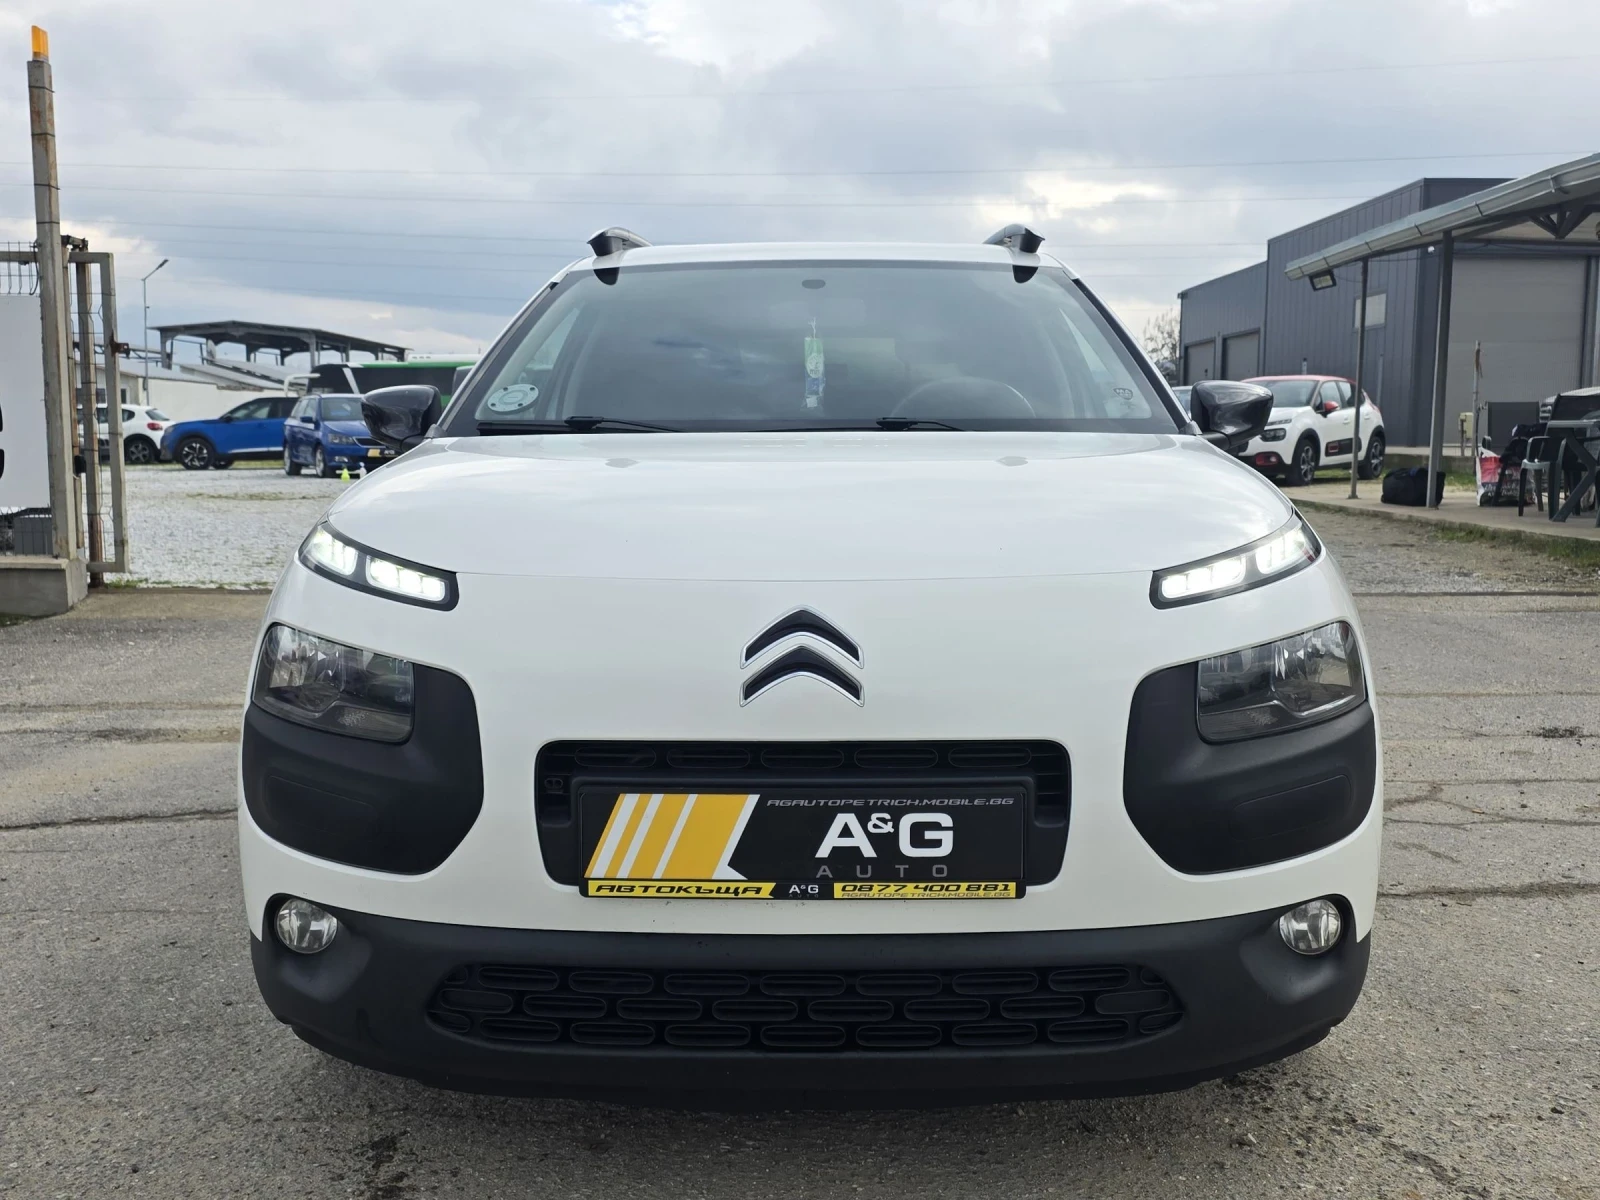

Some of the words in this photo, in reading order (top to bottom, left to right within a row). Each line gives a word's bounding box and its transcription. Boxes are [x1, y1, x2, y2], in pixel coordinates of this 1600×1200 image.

[766, 797, 1015, 807] AGAUTOPETRICH.MOBILE.BG
[814, 812, 954, 858] A&G
[595, 884, 762, 896] АВТОКЪЩА
[841, 884, 907, 892] 0877
[913, 884, 961, 892] 400
[965, 884, 1011, 892] 881
